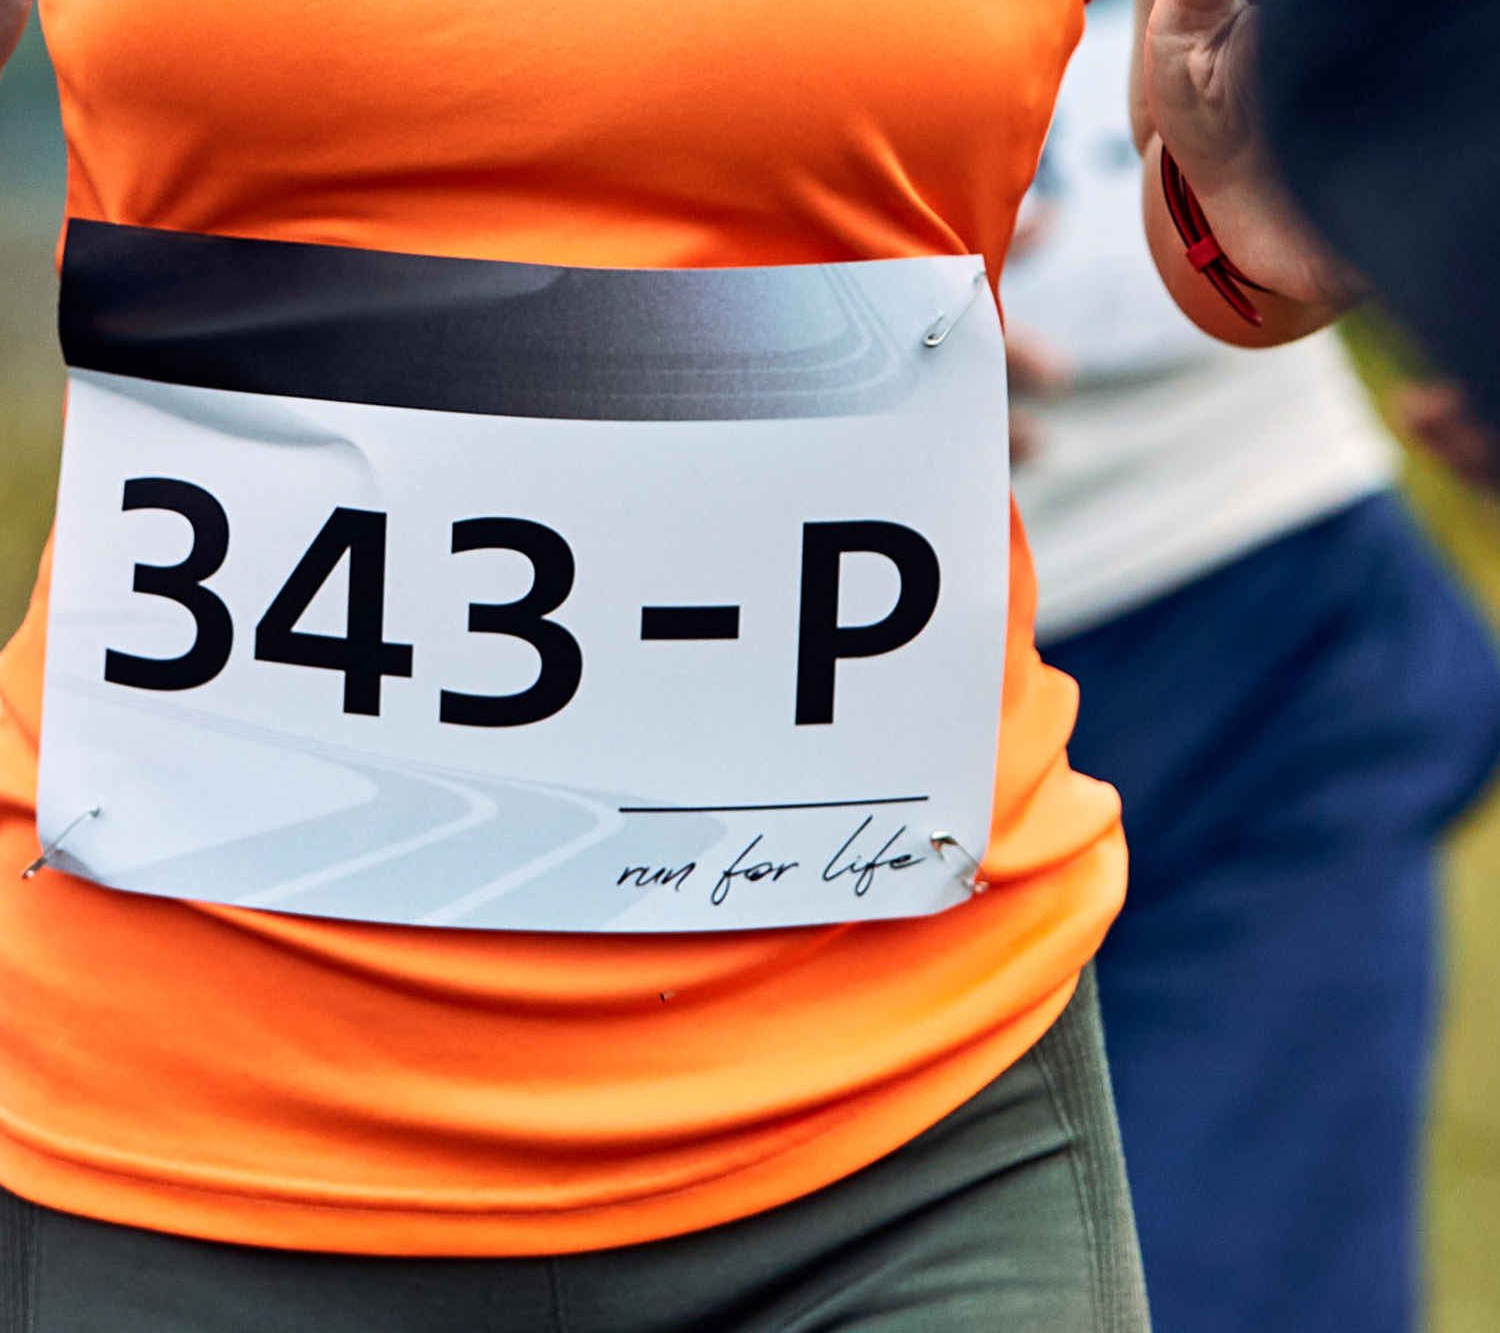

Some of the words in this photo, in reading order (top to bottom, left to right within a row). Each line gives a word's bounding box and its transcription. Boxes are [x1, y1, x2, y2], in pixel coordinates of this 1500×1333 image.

[103, 476, 942, 729] 343-P
[616, 861, 697, 892] run
[710, 833, 800, 906] for
[822, 814, 927, 898] life
